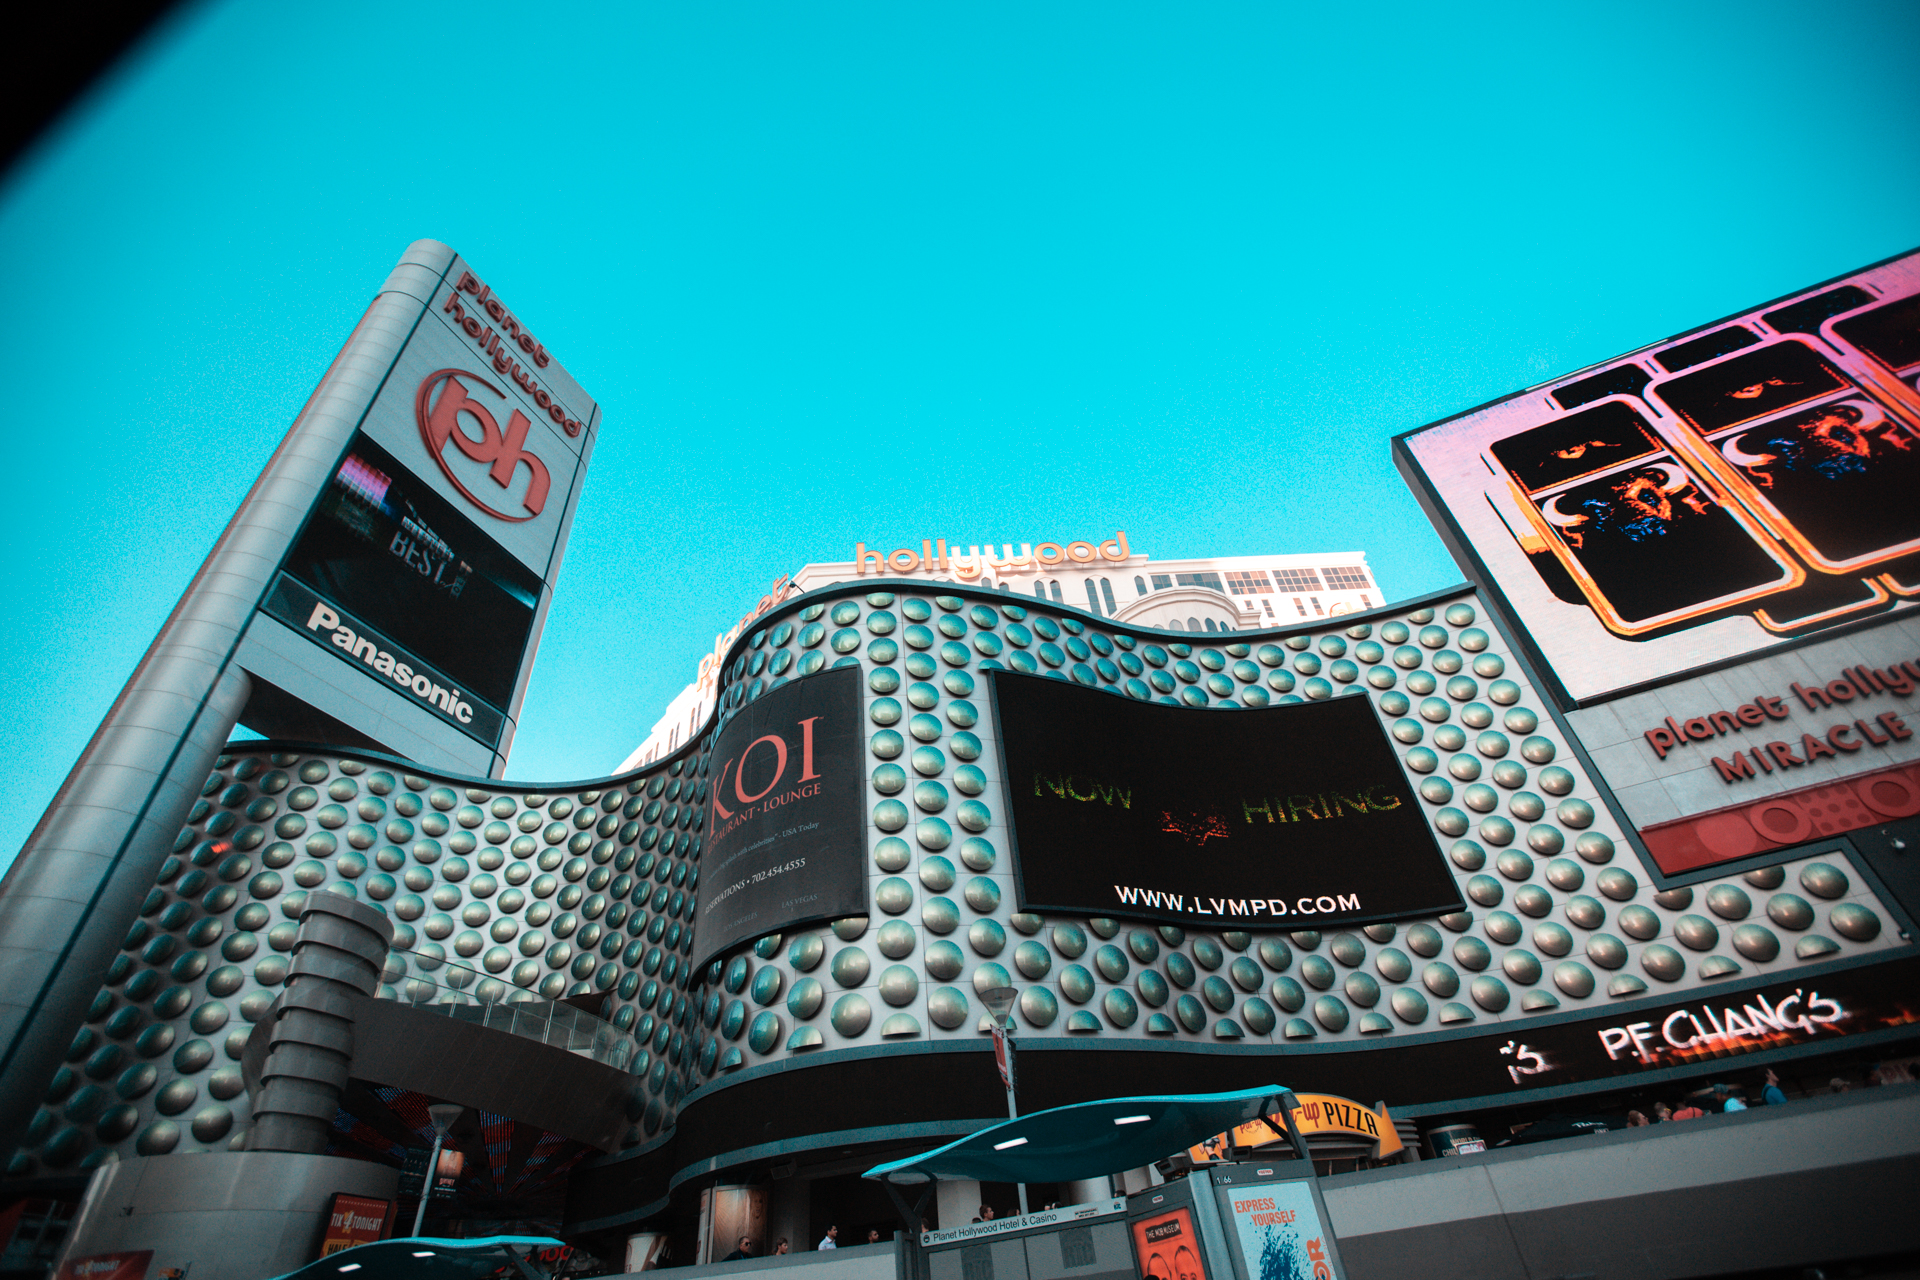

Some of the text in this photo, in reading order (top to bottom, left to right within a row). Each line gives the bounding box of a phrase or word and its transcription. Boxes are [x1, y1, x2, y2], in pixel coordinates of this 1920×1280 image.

[456, 271, 549, 368] planet
[443, 292, 582, 438] hollywood
[854, 529, 1131, 578] hollywood
[696, 572, 789, 693] planet
[306, 602, 474, 724] Panasonic
[1643, 695, 1790, 761] planet
[1710, 711, 1914, 785] MIRACLE
[708, 715, 821, 841] KOI
[763, 782, 822, 813] LOUNGE
[1034, 771, 1401, 824] NOW HIRING
[782, 828, 797, 838] USA
[797, 821, 820, 833] Today
[751, 857, 806, 884] 702.454.4555
[1114, 884, 1362, 917] WWW.LVMPD.COM
[1323, 1101, 1379, 1137] PIZZA
[331, 1211, 382, 1231] TIX 4 TONIGHT
[1234, 1197, 1276, 1214] EXPRESS
[1251, 1210, 1296, 1227] YOURSELF
[933, 1213, 1058, 1242] Planet Hollywood Hotel & Casino
[1145, 1221, 1181, 1239] THE MOB MUSEUM
